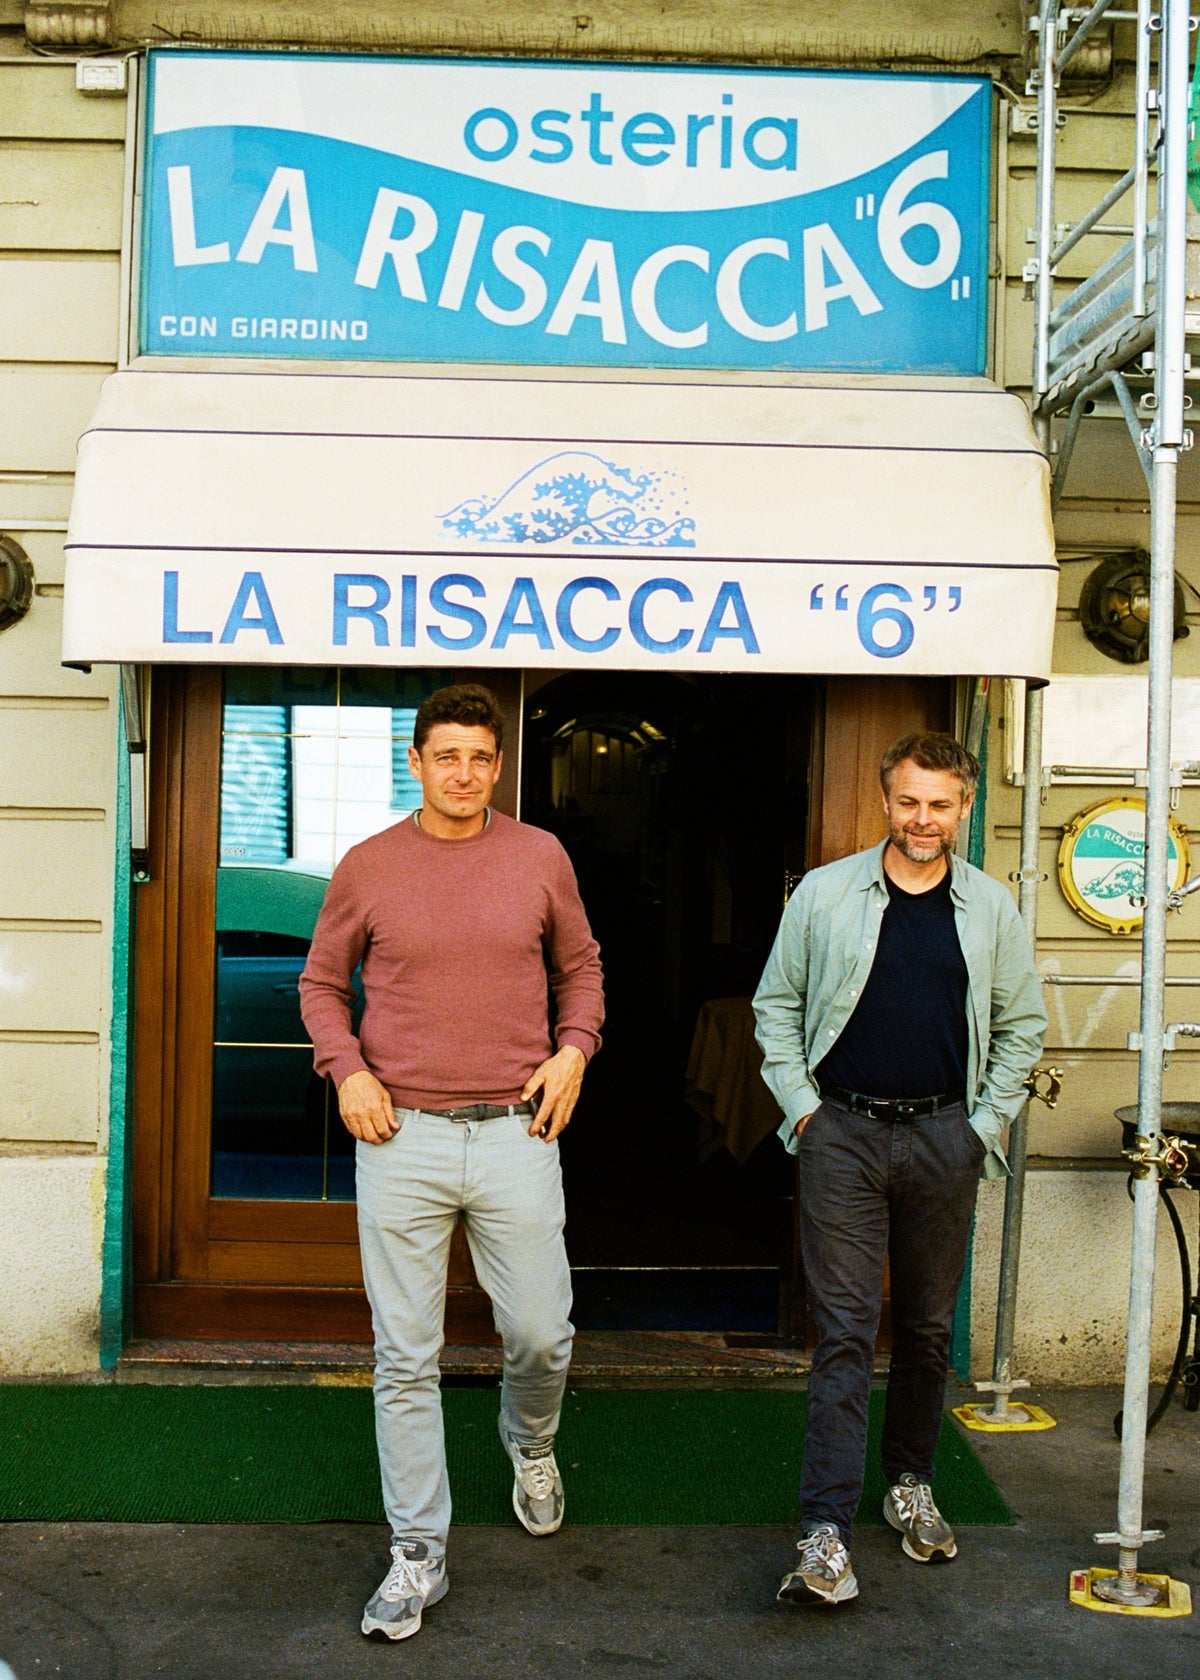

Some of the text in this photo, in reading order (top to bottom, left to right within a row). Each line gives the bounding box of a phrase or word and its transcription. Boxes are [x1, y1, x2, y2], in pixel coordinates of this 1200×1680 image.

[462, 92, 799, 172] osteria
[166, 165, 319, 273] LA
[353, 187, 884, 349] RISACCA
[159, 315, 369, 342] CON GIARDINO
[162, 571, 284, 645] LA
[332, 573, 760, 654] RISACCA
[1086, 829, 1101, 839] LA
[1127, 830, 1144, 838] oste
